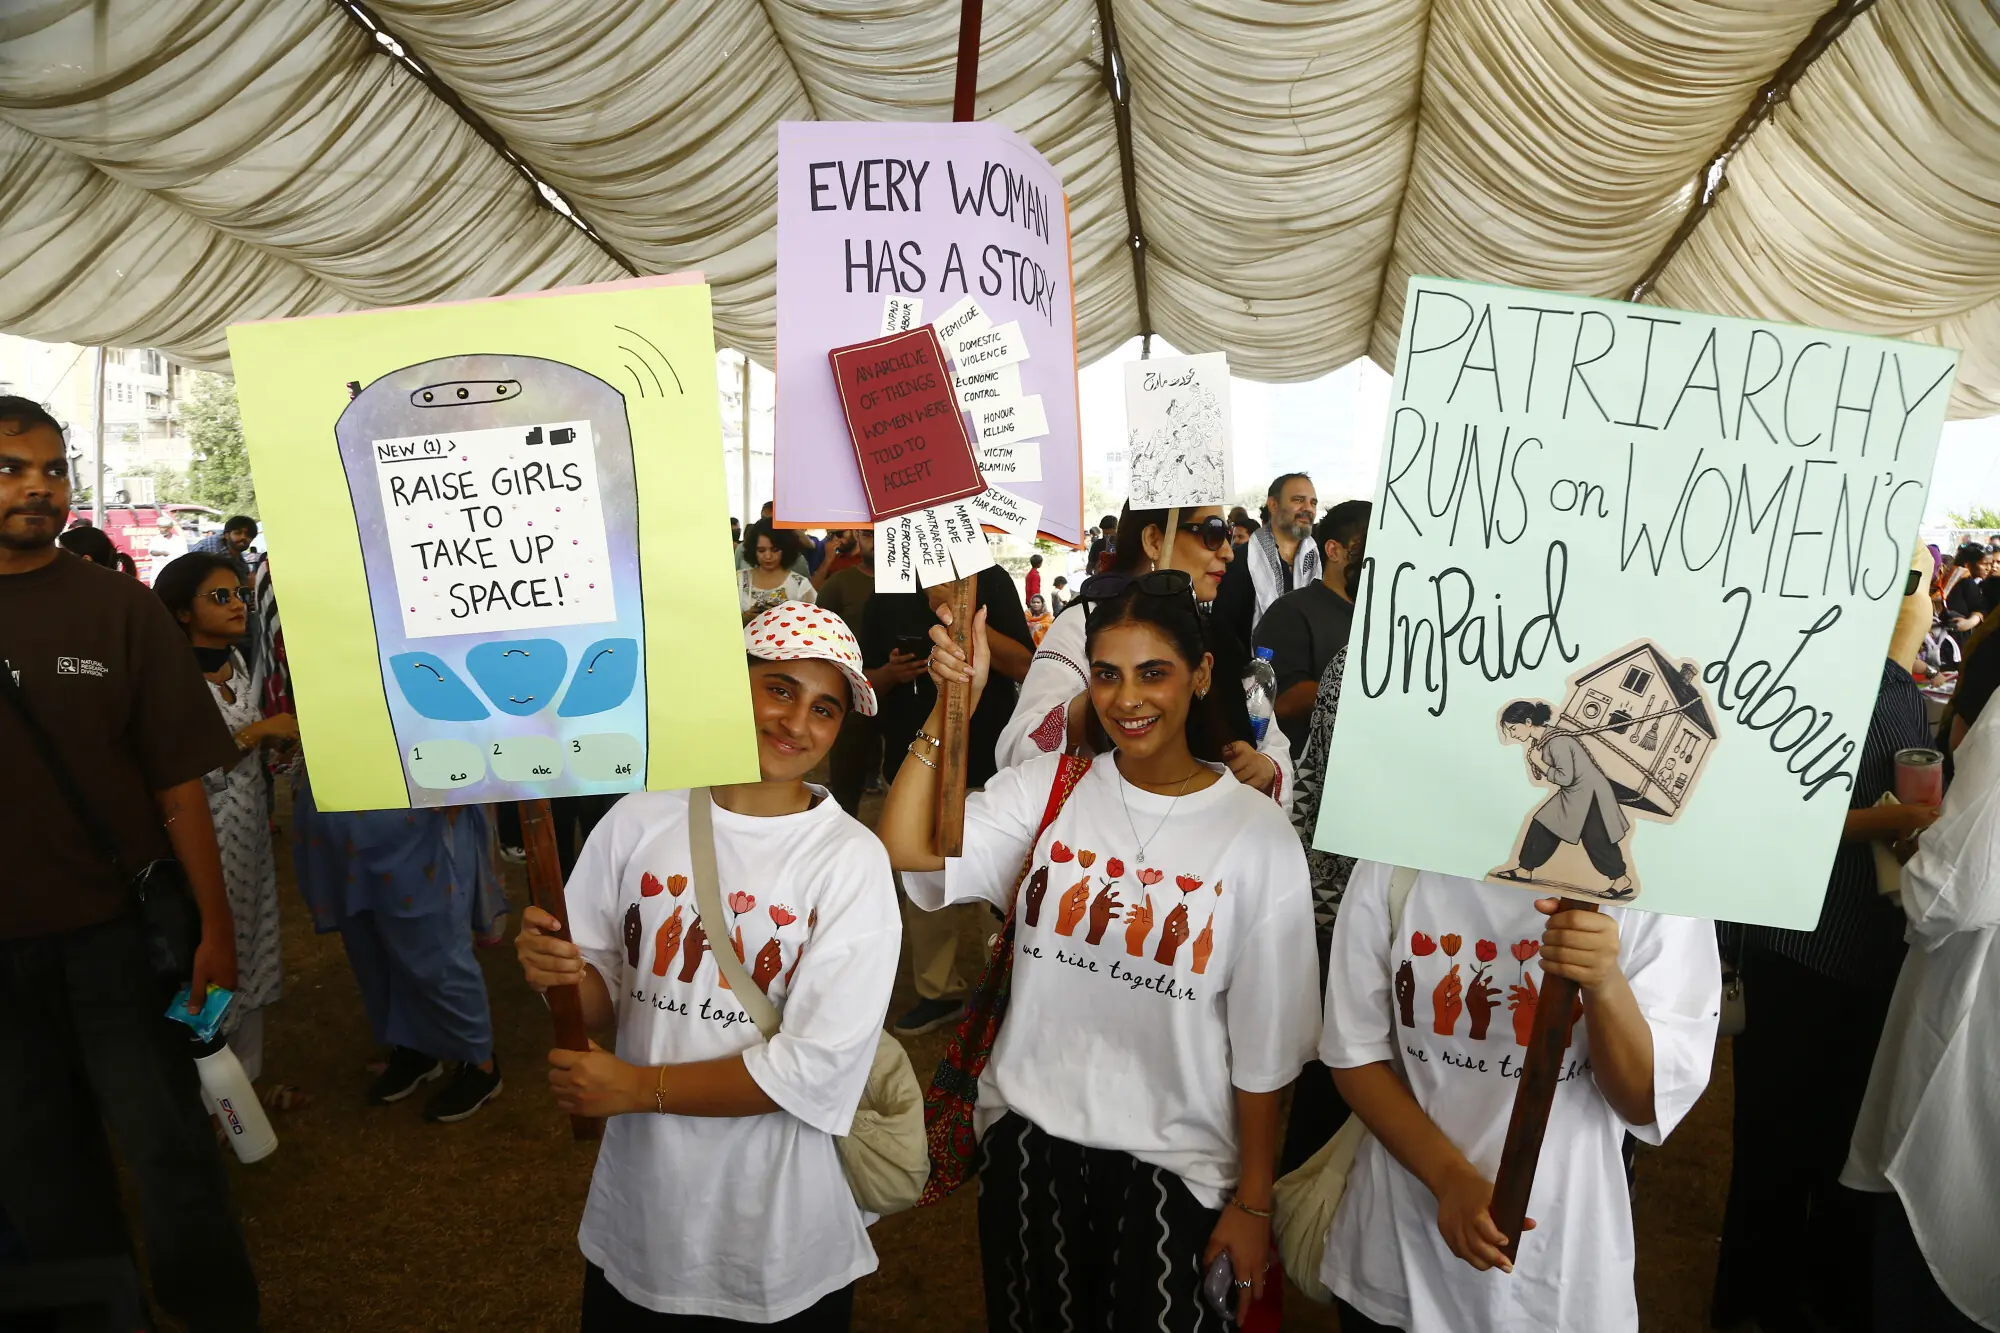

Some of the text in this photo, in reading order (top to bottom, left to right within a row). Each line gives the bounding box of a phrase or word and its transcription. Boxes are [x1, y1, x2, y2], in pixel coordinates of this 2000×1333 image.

[809, 158, 1049, 245] EVERY WOMAN
[845, 239, 1056, 327] HAS A STORY
[886, 300, 899, 332] UNPAID
[900, 303, 913, 332] ABOUR
[939, 306, 979, 341] FEMICIDE
[959, 332, 1001, 352] DOMESTIC
[960, 345, 1008, 367] VIOLENCE
[875, 348, 929, 379] ARCHIVE
[1402, 289, 1956, 462] PATRIARCHY
[859, 372, 937, 410] OF THINGS
[955, 371, 999, 388] ECONOMIC
[964, 388, 1000, 402] CONTROL
[862, 399, 950, 440] WOMEN WERE
[983, 406, 1015, 424] HONOUR
[983, 422, 1015, 438] KILLING
[377, 438, 442, 460] NEW (1)
[869, 435, 926, 466] TOLD TO
[983, 448, 1013, 458] VICTIM
[882, 459, 933, 493] ACCEPT
[979, 461, 1016, 472] BLAMING
[390, 461, 582, 506] RAISE GIRLS
[985, 487, 1018, 510] SEXUAL
[1379, 406, 1923, 600] RUNS on WOMEN'S
[460, 505, 503, 532] TO
[944, 519, 962, 544] RAPE
[954, 504, 976, 544] MARITAL
[410, 535, 554, 570] TAKE UP
[886, 526, 897, 567] CONTROL
[900, 516, 912, 582] REPRODUCTIVE
[914, 524, 935, 566] VIOLENCE
[923, 509, 946, 568] PATRIARCHAL
[450, 576, 564, 619] SPACE!
[81, 659, 103, 668] NATURAL
[81, 664, 109, 673] RESEARCH
[1702, 586, 1856, 801] Labour
[413, 747, 423, 760] 1
[493, 743, 502, 756] 2
[572, 740, 582, 753] 3
[532, 765, 552, 775] abc
[615, 764, 632, 775] def
[1023, 944, 1043, 959] we
[1056, 949, 1098, 972] rise
[652, 995, 688, 1016] rise
[1407, 1045, 1428, 1062] we
[1442, 1050, 1488, 1073] rise
